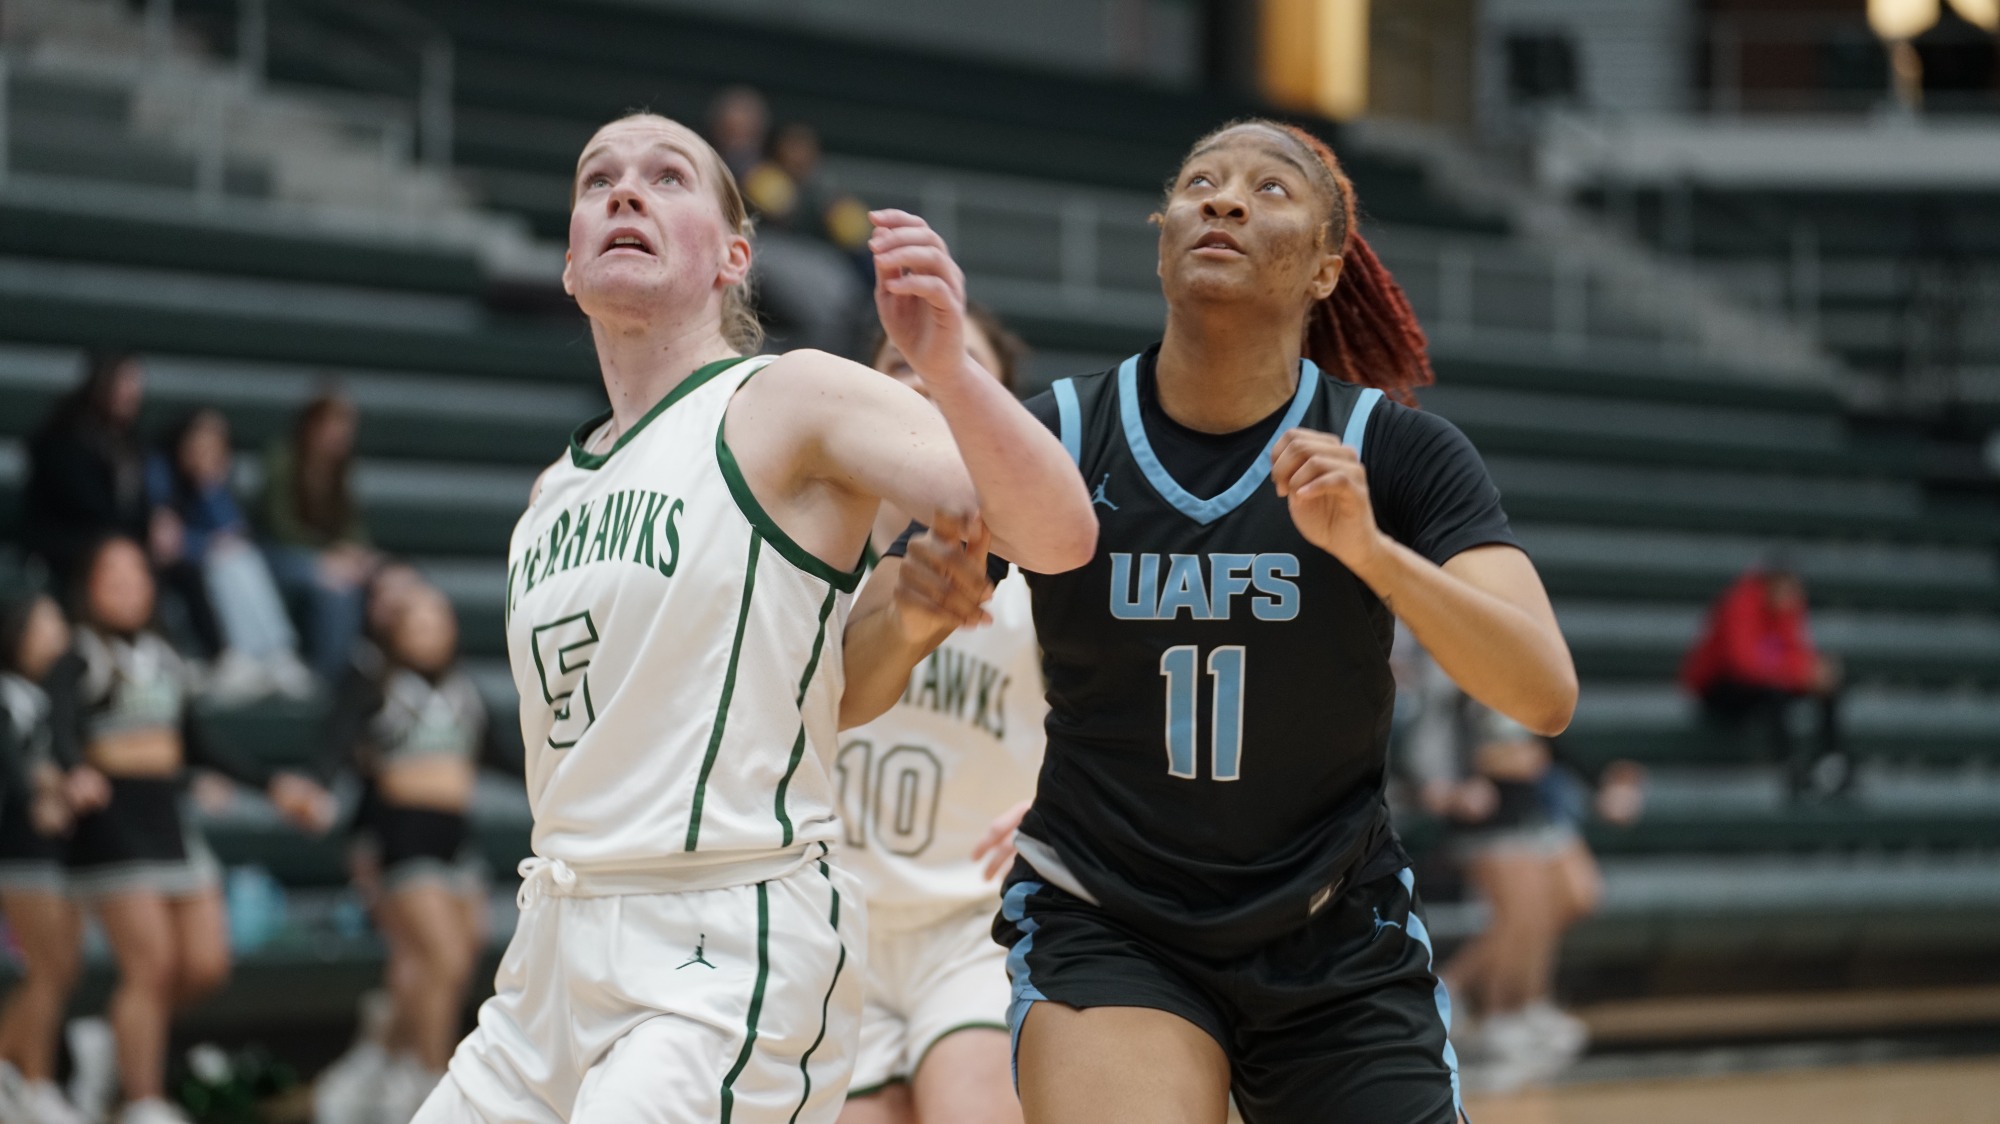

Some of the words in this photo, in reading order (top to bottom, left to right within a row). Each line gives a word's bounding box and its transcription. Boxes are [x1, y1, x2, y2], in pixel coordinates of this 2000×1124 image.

[1109, 552, 1300, 622] UAFS
[531, 609, 600, 750] 5
[1159, 644, 1247, 782] 11
[835, 738, 943, 859] 10
